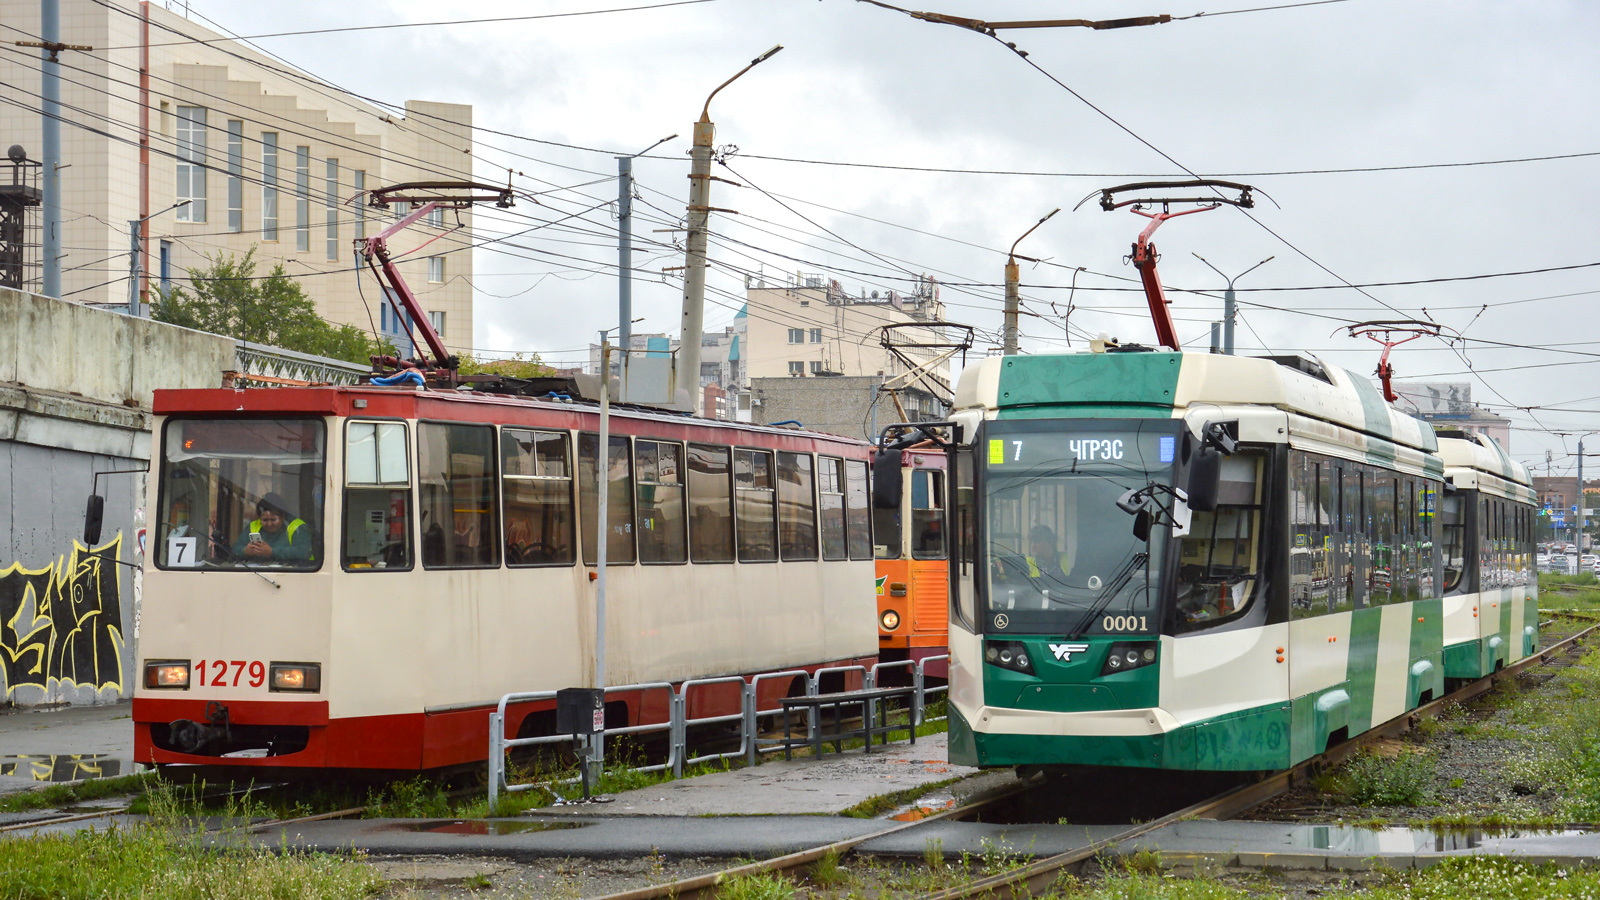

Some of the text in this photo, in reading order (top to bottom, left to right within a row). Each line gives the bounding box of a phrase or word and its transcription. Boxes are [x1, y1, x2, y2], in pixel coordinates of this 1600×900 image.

[1012, 439, 1124, 461] 7 ЧГРЭС
[175, 542, 187, 563] 7
[1102, 615, 1148, 631] 0001
[194, 659, 266, 688] 1279
